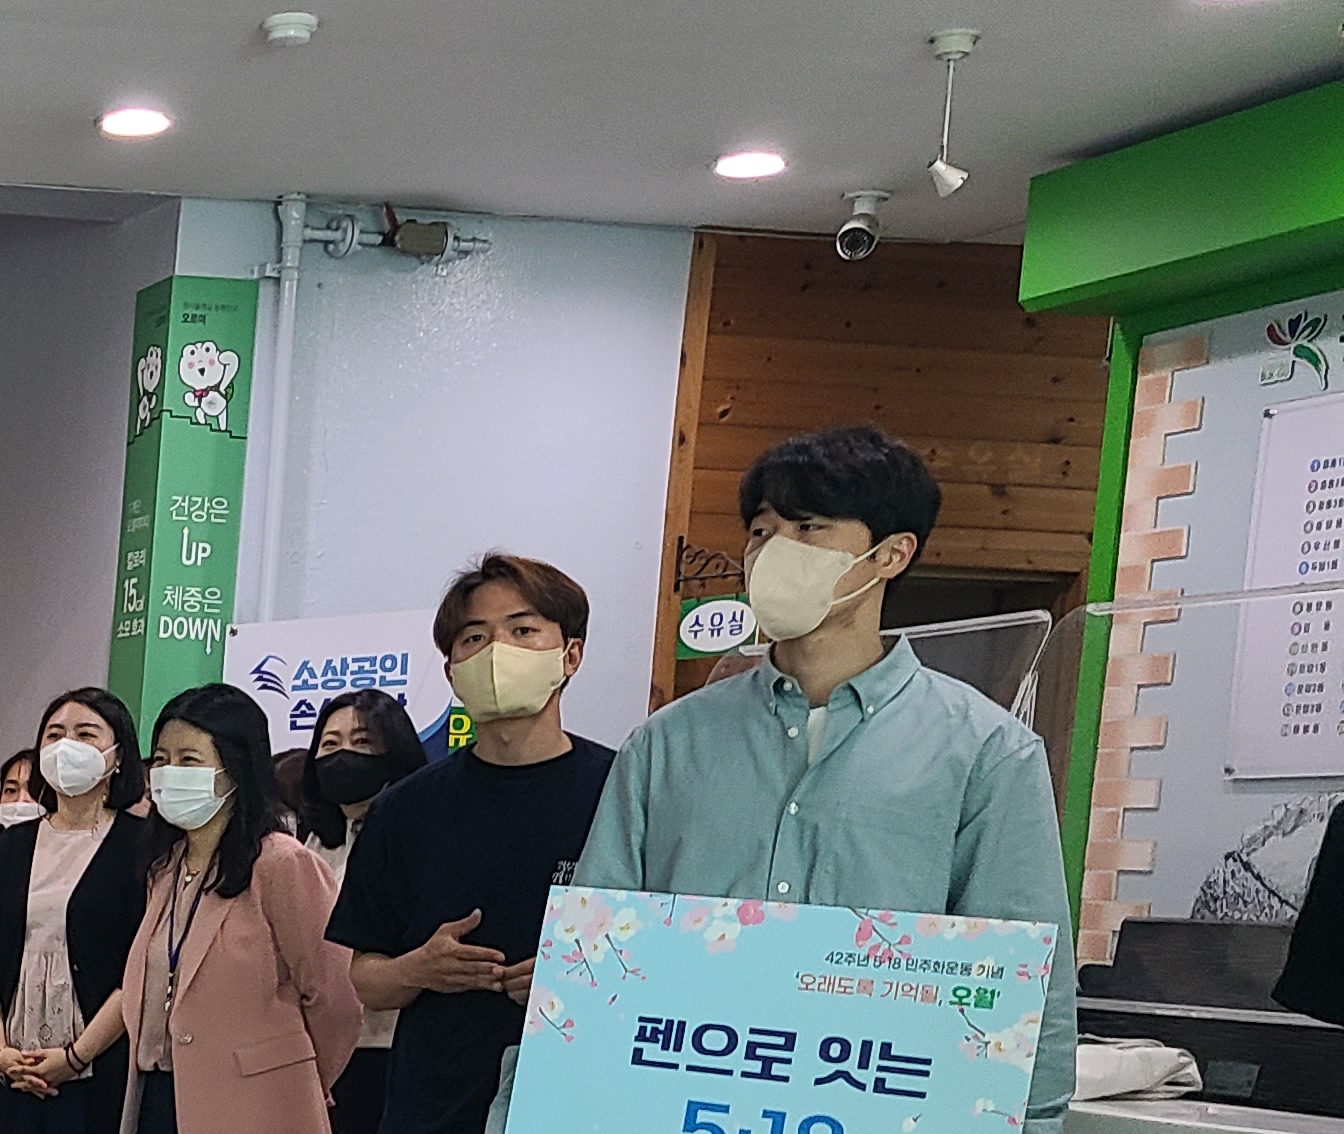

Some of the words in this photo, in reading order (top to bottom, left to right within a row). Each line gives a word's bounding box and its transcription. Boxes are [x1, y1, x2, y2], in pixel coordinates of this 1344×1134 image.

[169, 495, 230, 523] 건강은
[181, 526, 212, 567] UP
[162, 586, 223, 614] 체중은
[159, 615, 222, 655] DOWN
[688, 609, 745, 640] 수유실
[291, 652, 409, 693] 소상공인
[824, 950, 870, 968] 42주년
[905, 957, 973, 977] 민주화운동
[630, 1015, 798, 1084] 펜으로
[812, 1035, 934, 1100] 잇는
